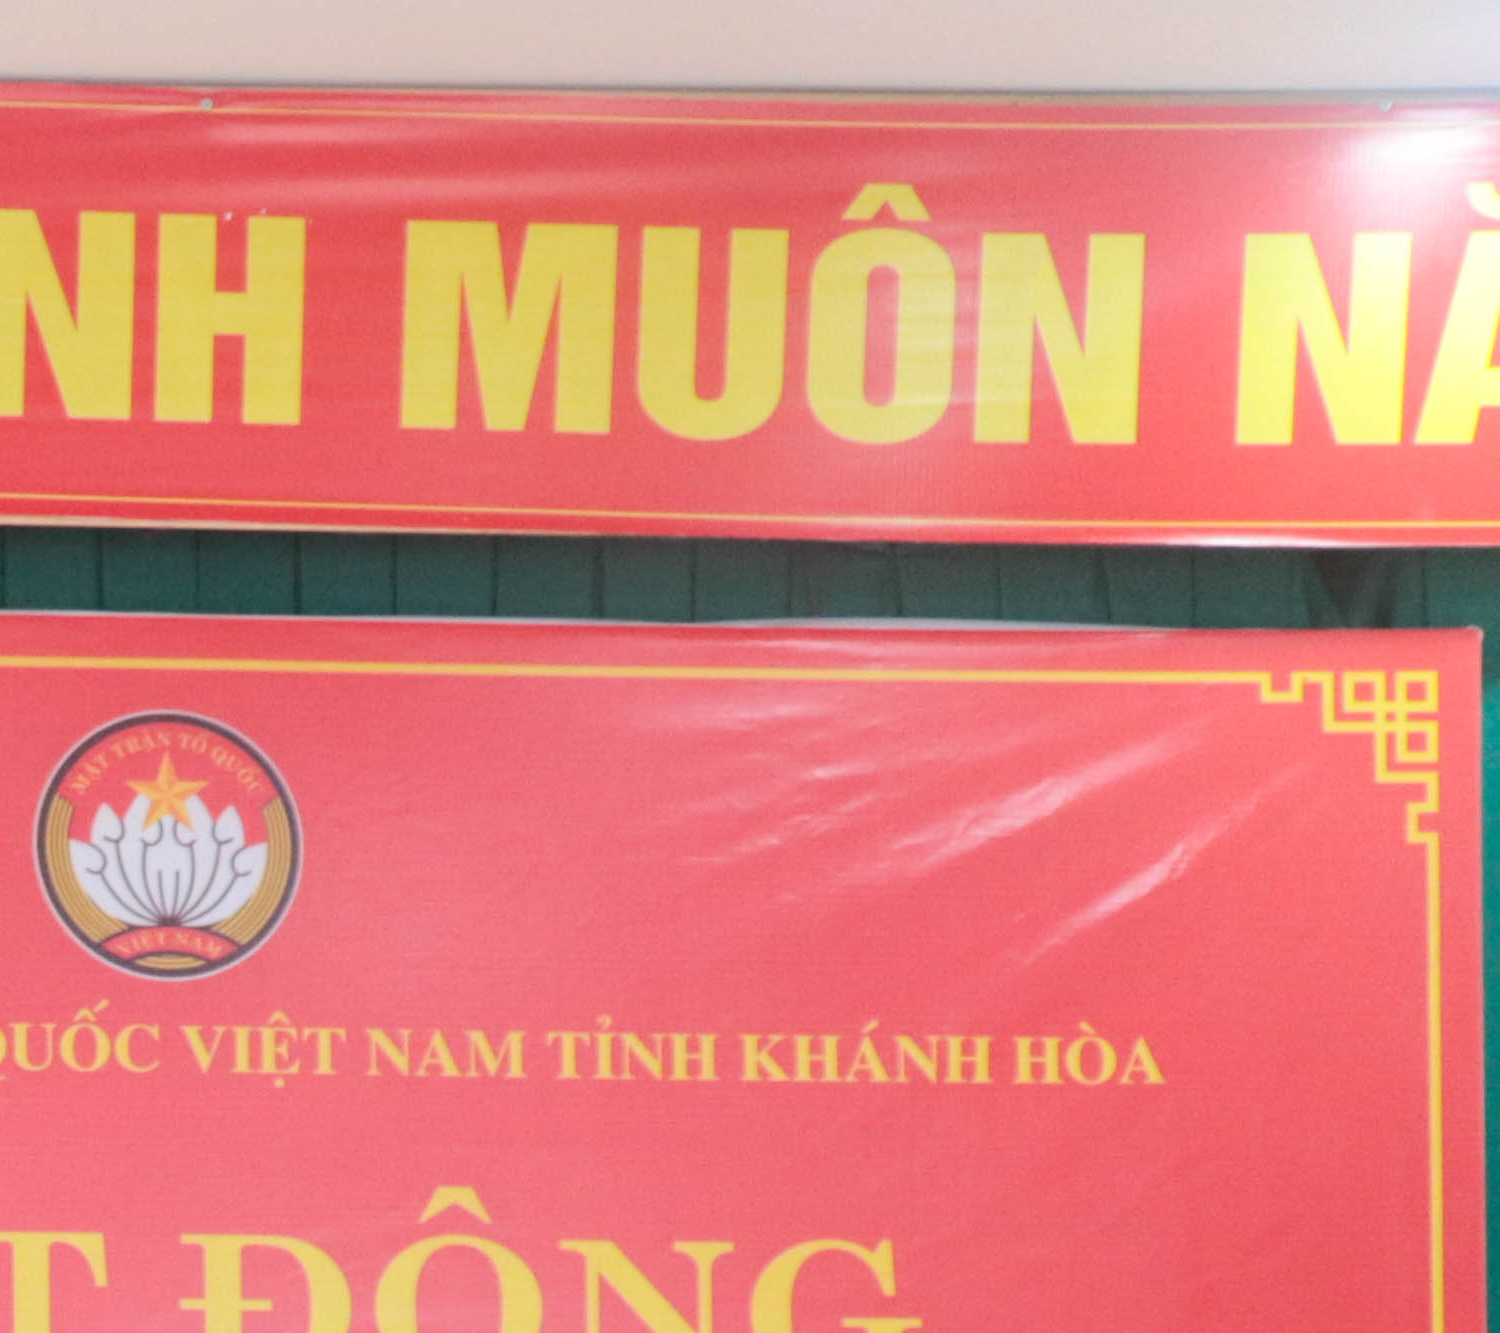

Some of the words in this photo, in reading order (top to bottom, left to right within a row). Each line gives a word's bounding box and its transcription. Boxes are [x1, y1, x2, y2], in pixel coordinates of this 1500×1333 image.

[398, 183, 1146, 444] MUÔN
[181, 1013, 346, 1088] VIỆT
[366, 1027, 525, 1079] NAM
[546, 1014, 719, 1083] TỈNH
[740, 1016, 994, 1085] KHÁNH
[1010, 1022, 1165, 1086] HÒA
